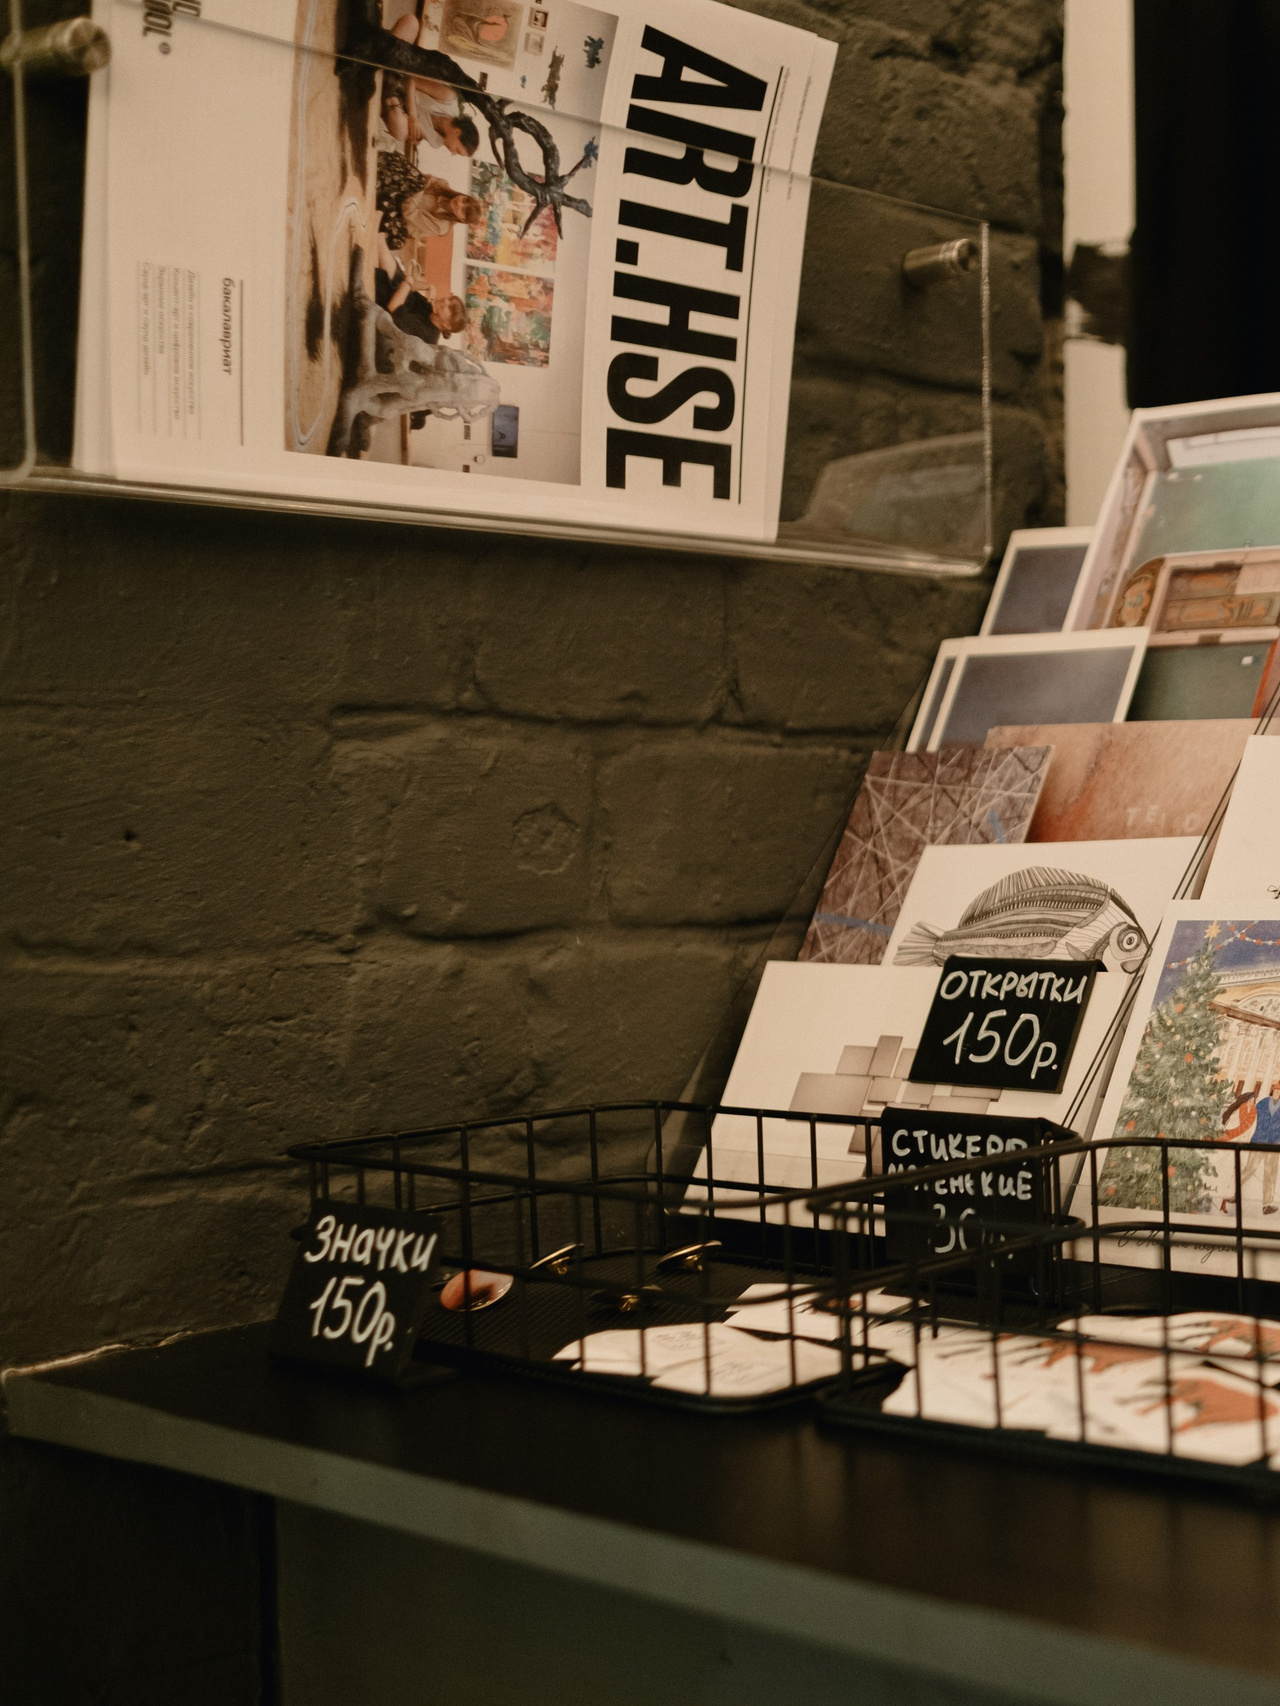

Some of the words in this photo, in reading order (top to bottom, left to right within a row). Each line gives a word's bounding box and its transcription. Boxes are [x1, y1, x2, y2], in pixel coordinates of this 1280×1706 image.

[606, 24, 768, 500] ART.HSE
[219, 277, 235, 376] бакалавриат
[940, 970, 1087, 1004] ОТКРЫТКИ
[943, 1009, 1057, 1079] 150р.
[309, 1276, 396, 1367] 150р.
